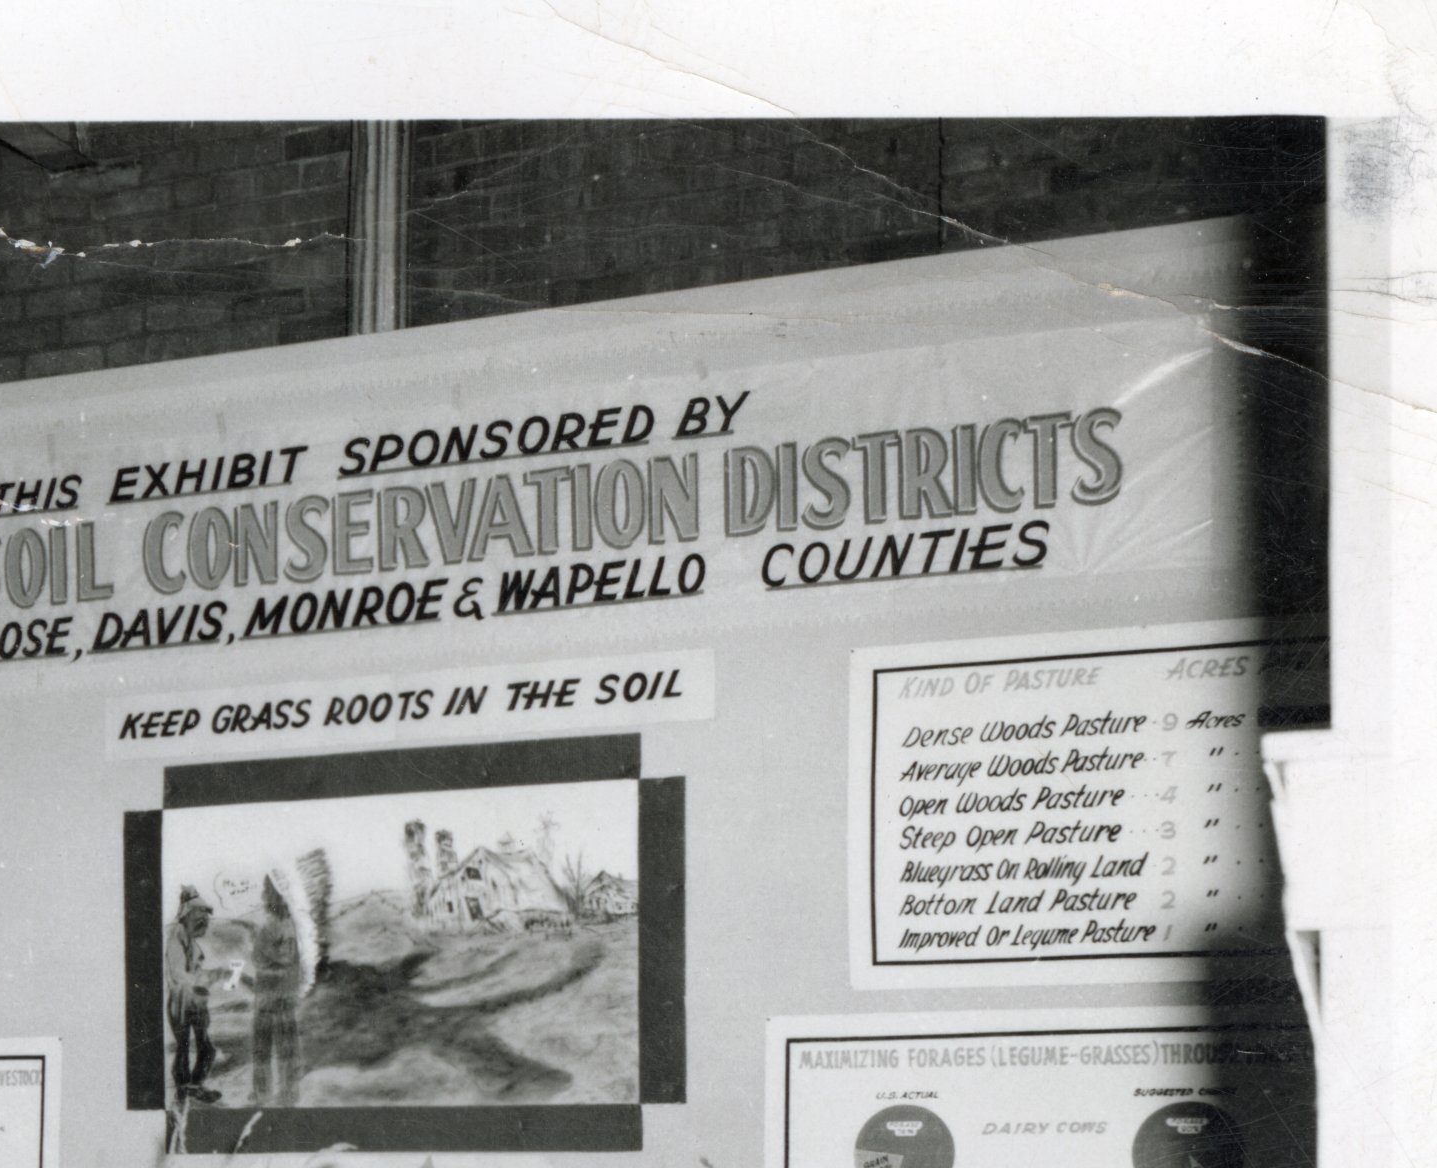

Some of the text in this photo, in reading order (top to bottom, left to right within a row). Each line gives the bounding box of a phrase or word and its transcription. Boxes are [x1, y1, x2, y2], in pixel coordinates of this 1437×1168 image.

[111, 445, 308, 502] EXHIBIT
[338, 404, 655, 477] SPONSORED
[674, 391, 750, 438] BY
[143, 452, 700, 595] CONSERVATION
[724, 407, 1123, 538] DISTRICTS
[88, 601, 236, 653] DAVIS,
[240, 578, 449, 639] MONROE
[453, 578, 485, 620] &
[496, 553, 705, 614] WAPELLO
[760, 520, 1050, 588] COUNTIES
[898, 676, 955, 699] KIND
[964, 671, 994, 695] OF
[1003, 667, 1102, 692] PASTURE
[1166, 656, 1250, 681] ACRES
[118, 669, 684, 741] KEEP GRASS ROOTS IN THE SOIL
[902, 710, 1246, 748] Dense Woods Pasture 9 Acres
[900, 746, 1177, 787] Average Woods Pasture 7
[899, 784, 1178, 822] Open Woods Pasture 4
[899, 819, 1176, 854] Steep Open Pasture 3
[900, 851, 1176, 888] Bluegrass On Rolling Land 2
[899, 887, 1176, 916] Bottom Land Pasture 2
[898, 925, 982, 953] Improved
[986, 925, 1010, 946] Or
[1010, 924, 1079, 950] Legume
[1080, 918, 1156, 944] Pasture
[798, 1048, 899, 1069] MAXIMIZING
[907, 1046, 986, 1068] FORAGES
[981, 1121, 1108, 1135] DAIRY COWS
